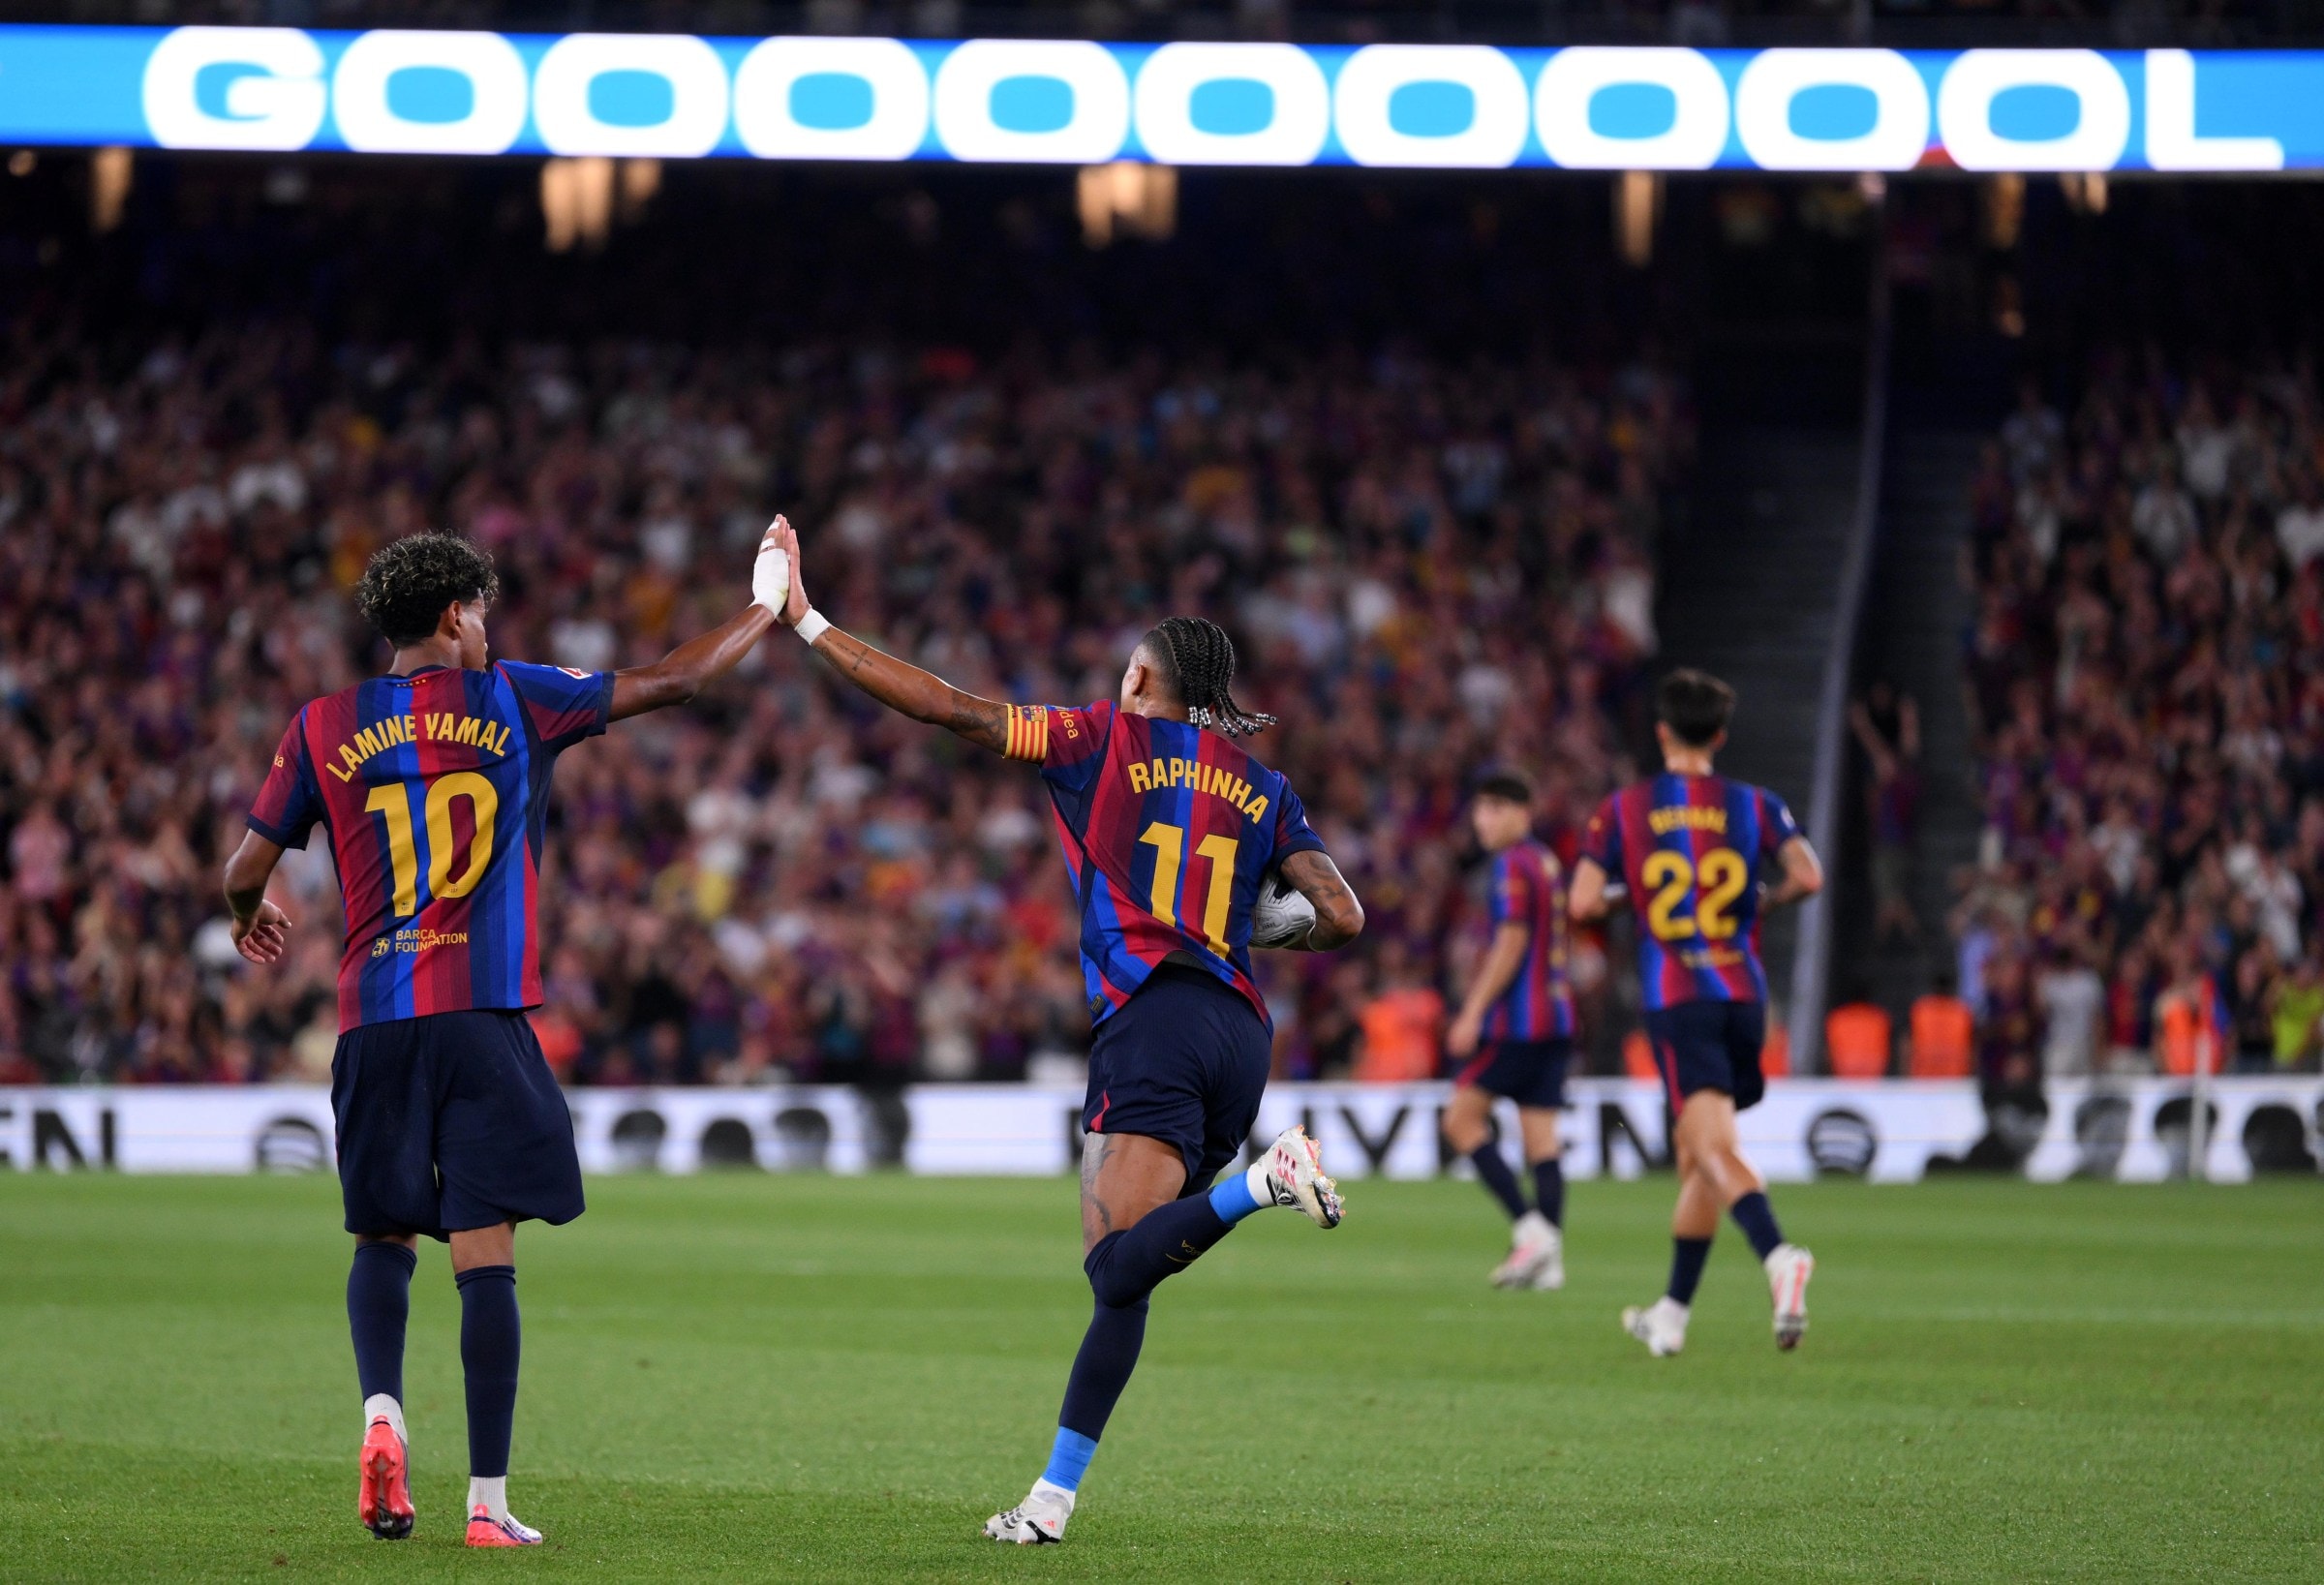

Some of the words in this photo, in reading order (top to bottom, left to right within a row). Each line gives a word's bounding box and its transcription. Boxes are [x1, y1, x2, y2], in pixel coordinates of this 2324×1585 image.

[143, 26, 2284, 171] GOOOOOOOOOL
[326, 716, 416, 783] LAMINE
[425, 713, 510, 757] YAMAL
[1127, 757, 1269, 825] RAPHINHA
[364, 772, 499, 917] 10
[1139, 821, 1238, 960] 11
[395, 930, 436, 942] BARÇA
[1642, 848, 1748, 941] 22
